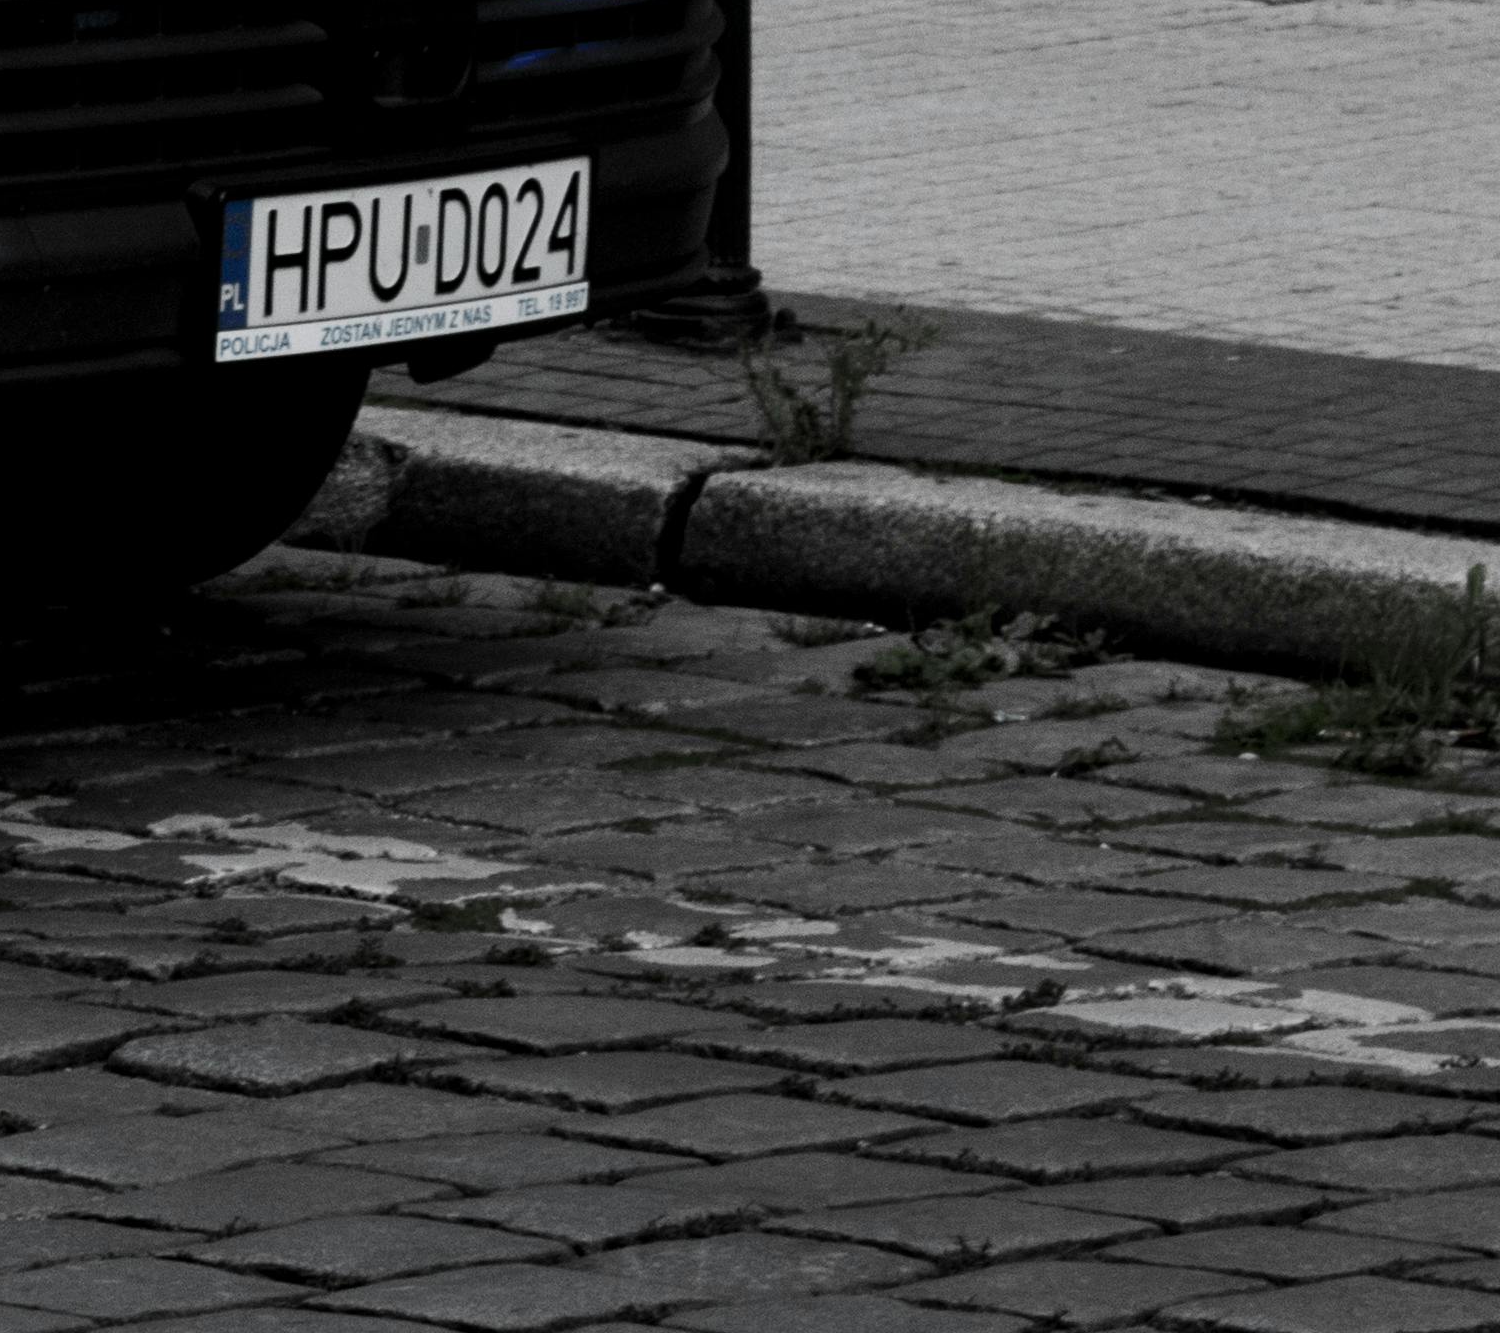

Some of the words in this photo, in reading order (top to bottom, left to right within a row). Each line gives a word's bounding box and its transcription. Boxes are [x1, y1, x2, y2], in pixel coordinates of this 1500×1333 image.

[265, 194, 412, 317] HPU
[219, 282, 246, 313] PL
[220, 331, 291, 357] POLICJA
[320, 316, 382, 346] ZOSTAŃ
[385, 310, 446, 339] JEDNYM
[448, 311, 460, 329] Z
[461, 304, 492, 327] NAS
